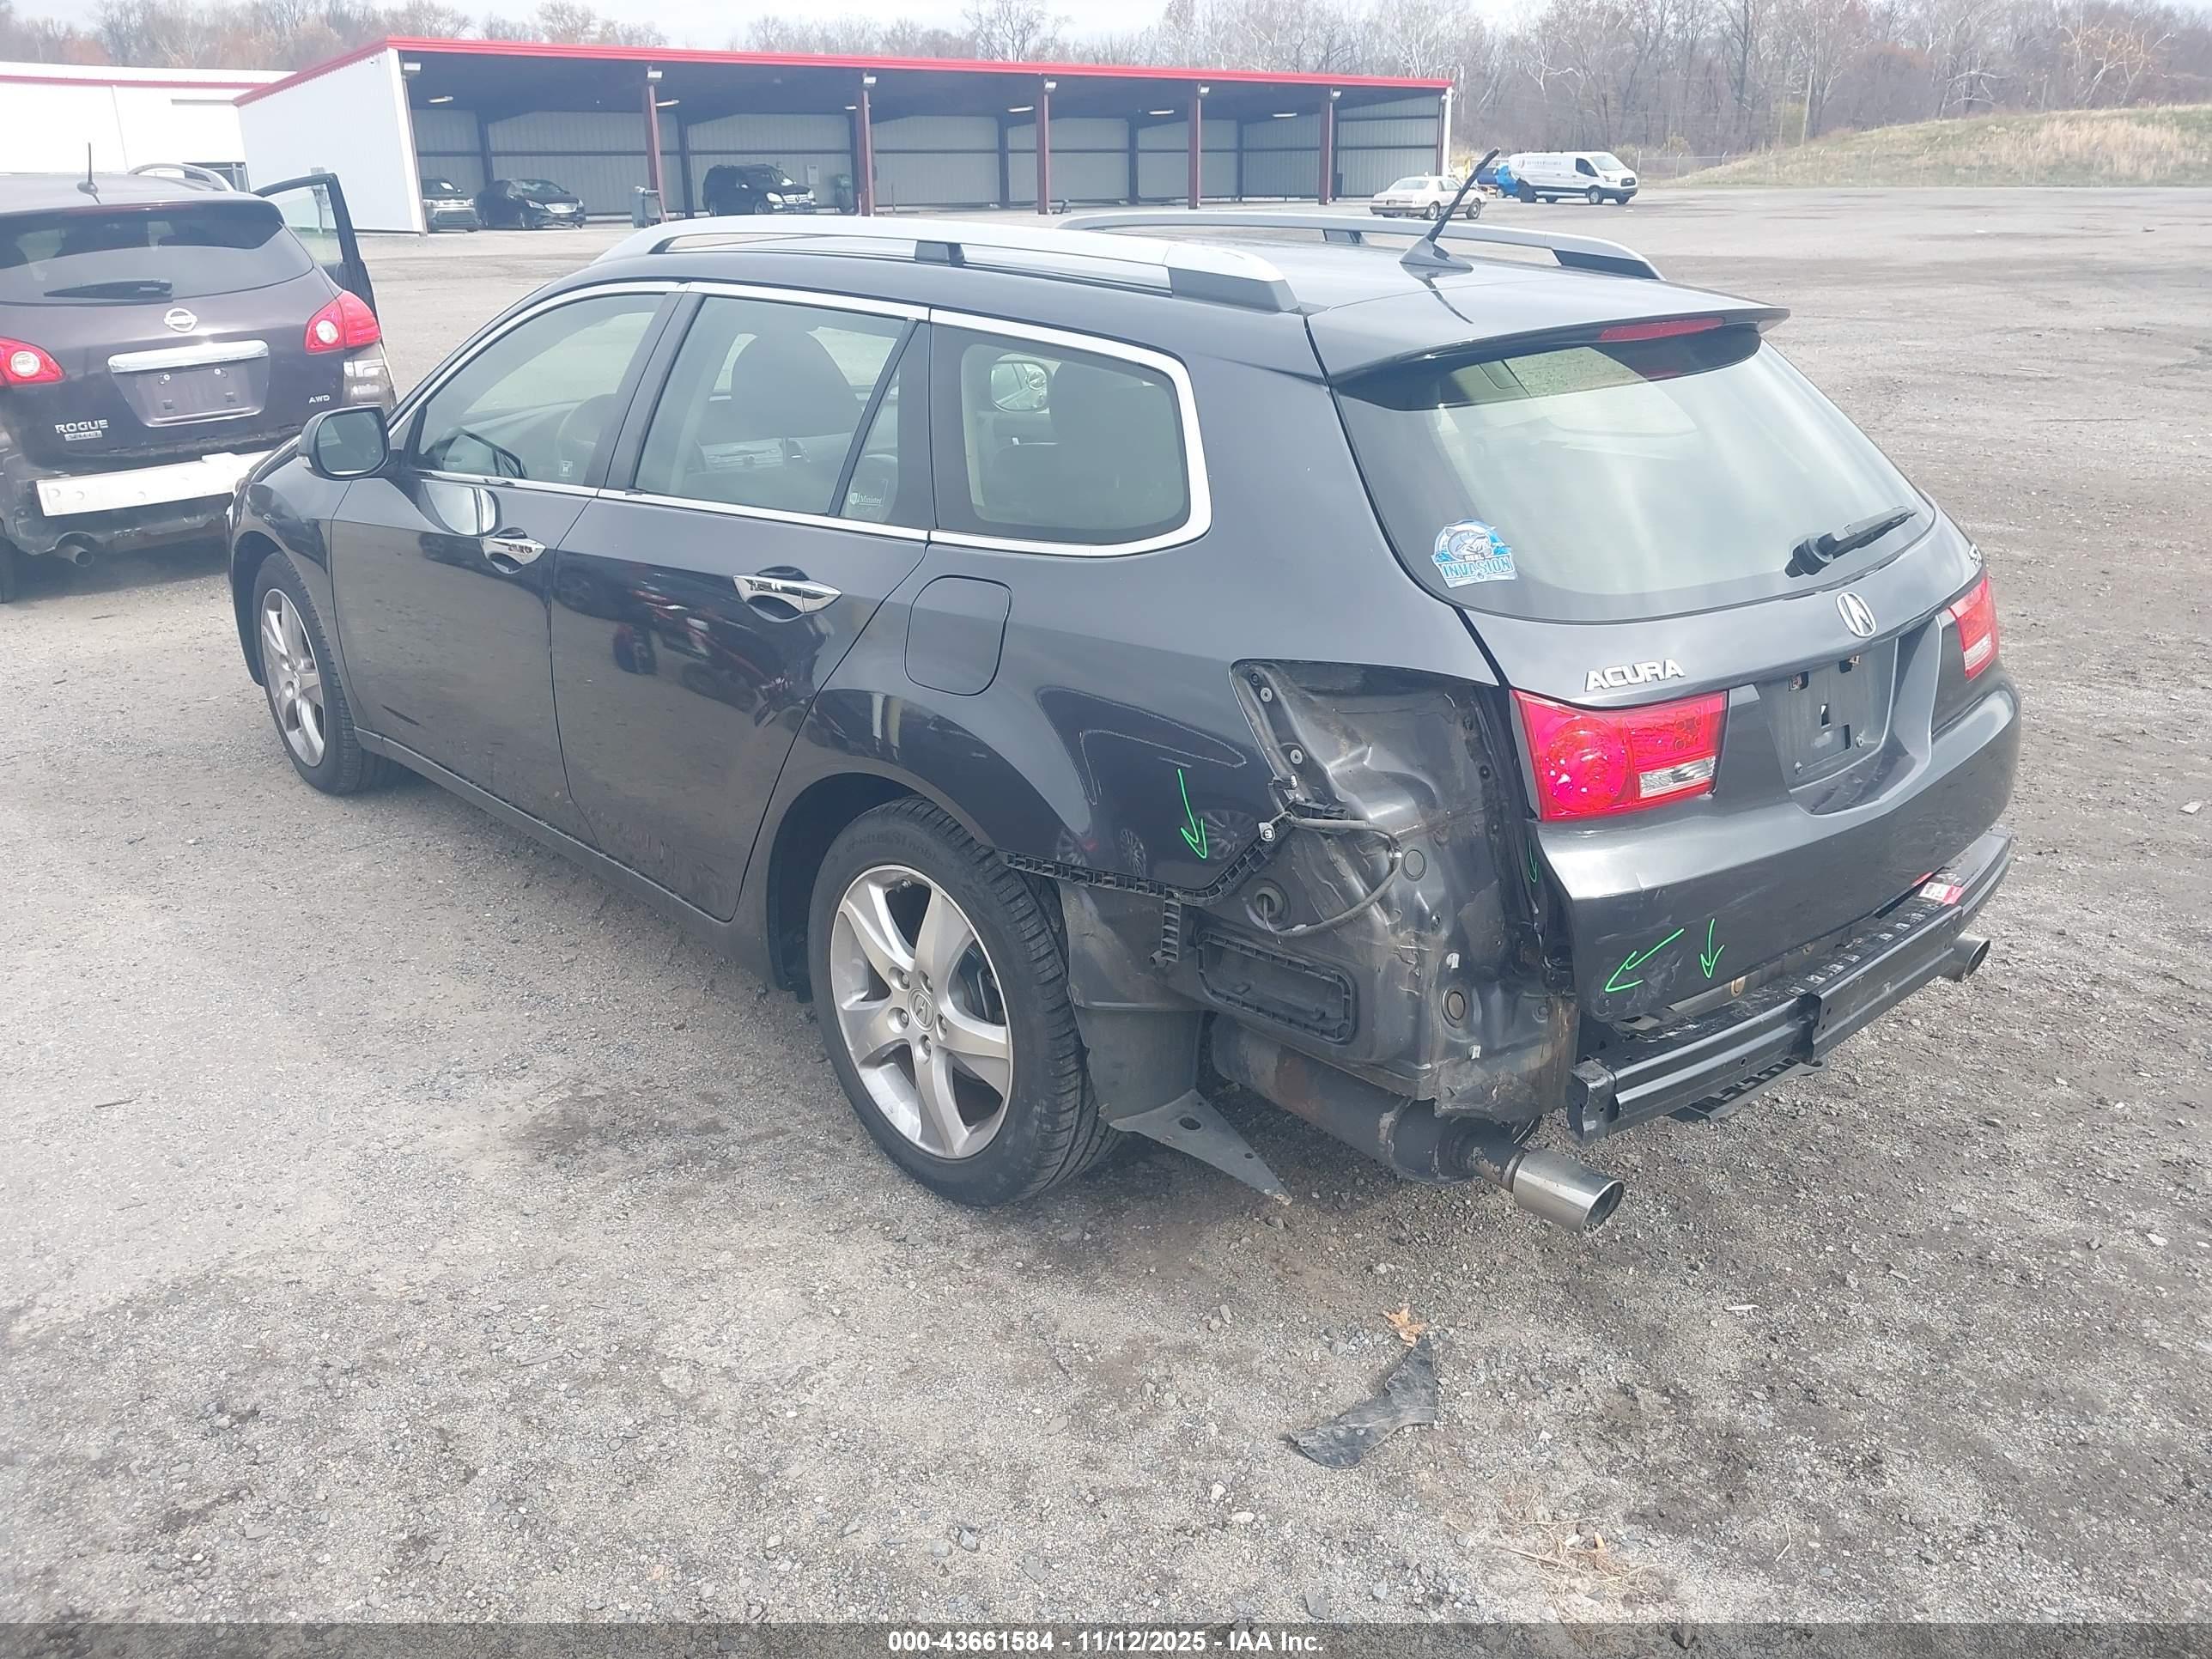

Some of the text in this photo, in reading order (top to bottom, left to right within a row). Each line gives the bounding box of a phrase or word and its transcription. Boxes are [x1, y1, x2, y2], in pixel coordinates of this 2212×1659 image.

[309, 395, 331, 404] AWD
[54, 419, 109, 434] ROGUE
[1442, 556, 1514, 579] INVASION
[1584, 659, 1685, 692] ACURA
